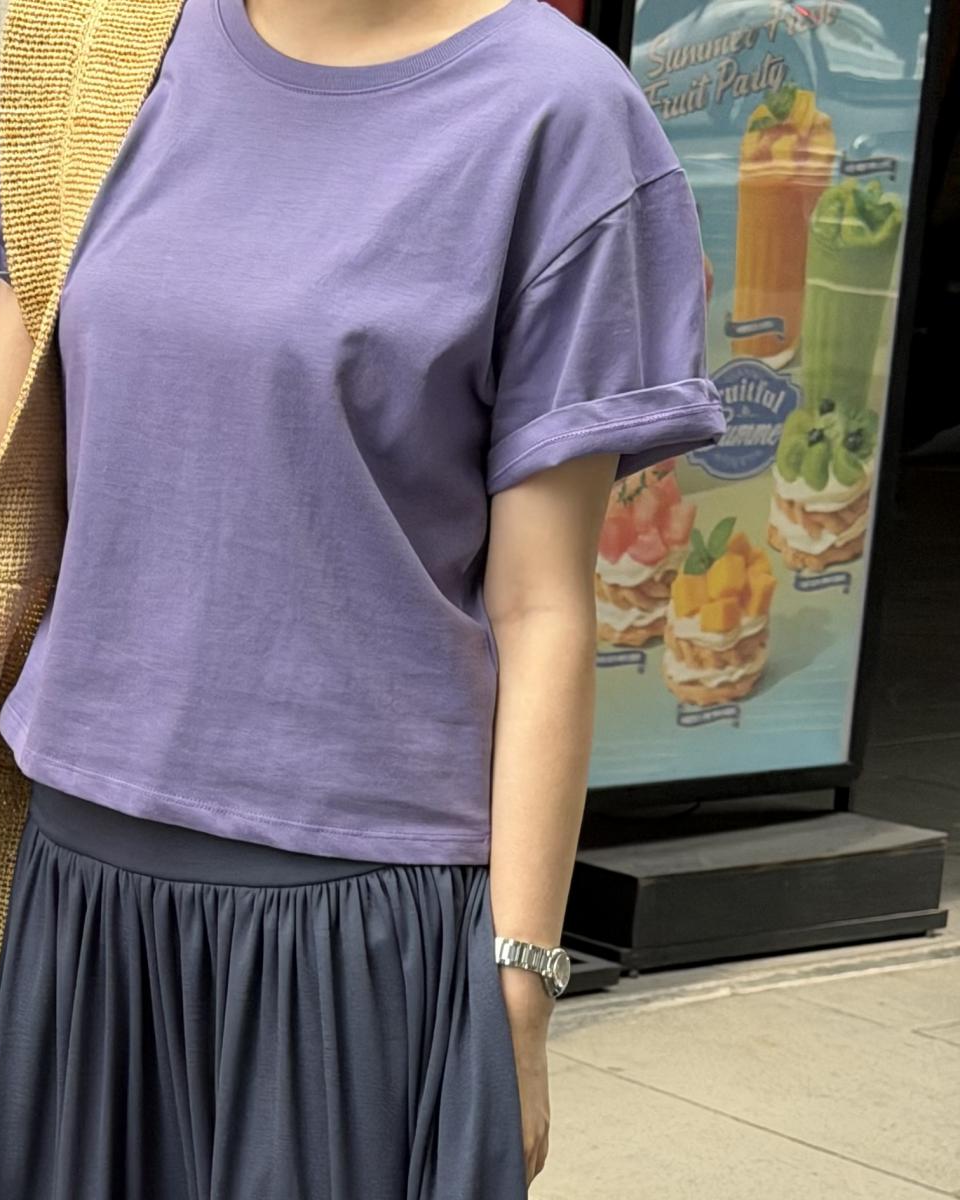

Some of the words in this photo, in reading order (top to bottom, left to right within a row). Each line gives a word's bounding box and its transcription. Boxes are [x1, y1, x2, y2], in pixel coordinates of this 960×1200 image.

[646, 28, 760, 78] Summer
[643, 73, 713, 120] Fruit
[716, 52, 788, 103] Party
